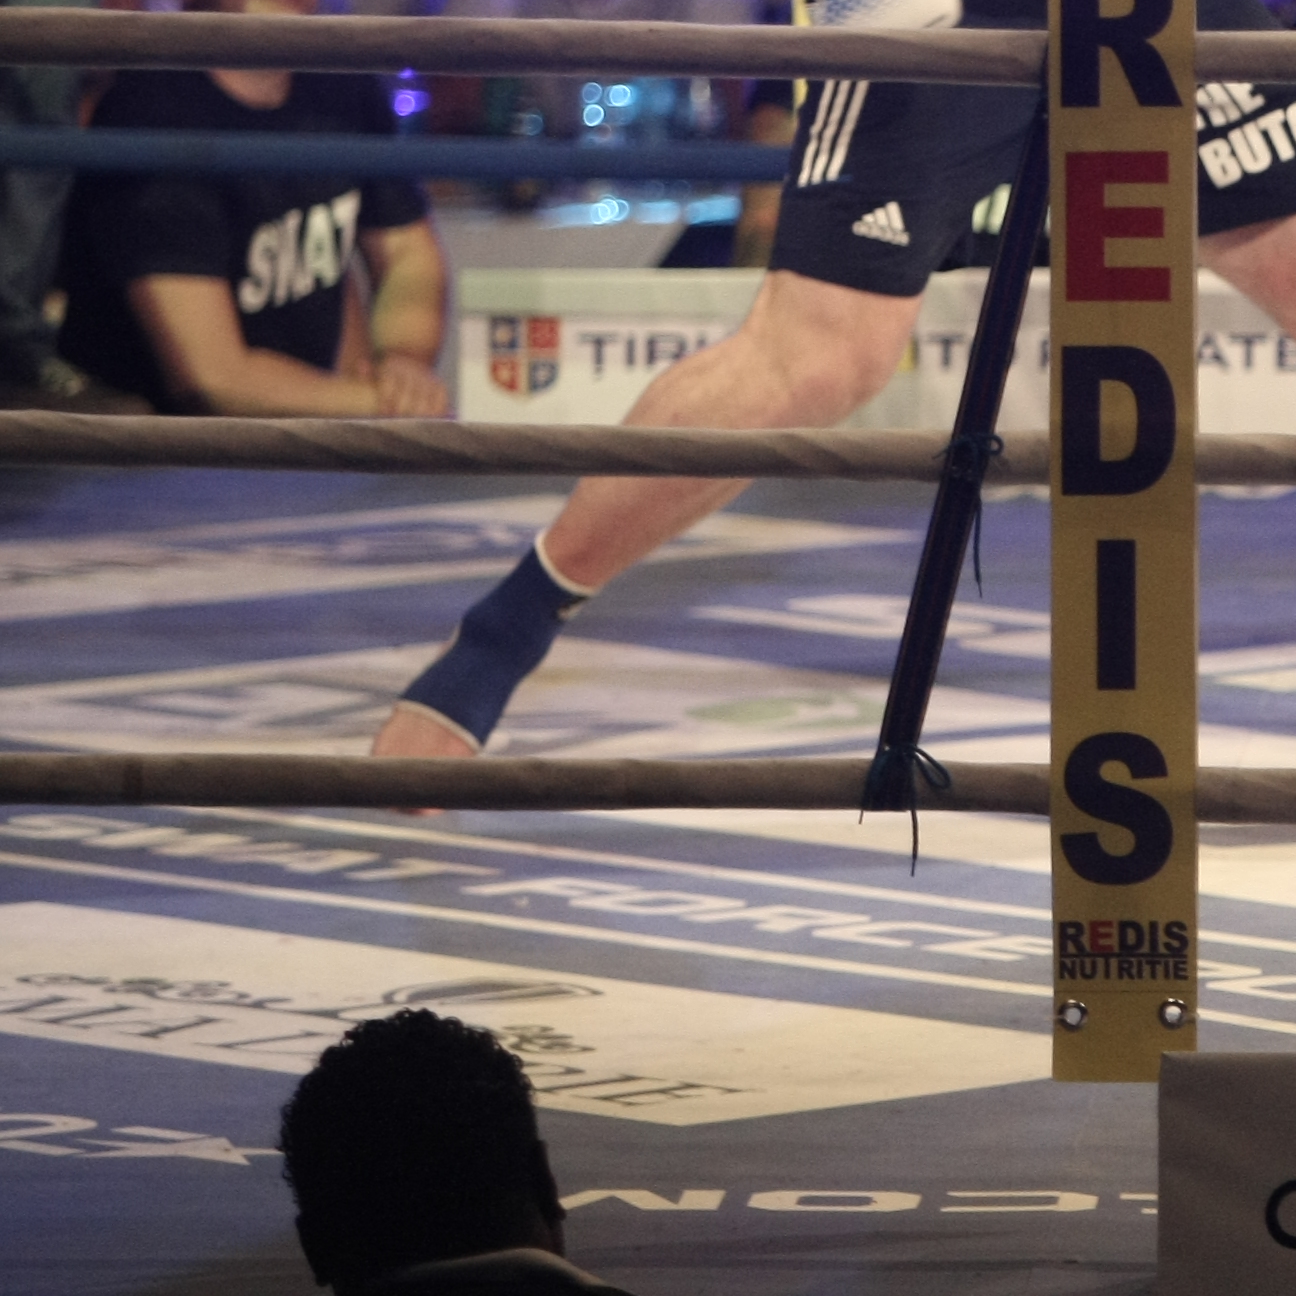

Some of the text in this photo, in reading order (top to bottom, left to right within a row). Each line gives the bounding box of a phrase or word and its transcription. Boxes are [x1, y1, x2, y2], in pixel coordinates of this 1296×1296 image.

[238, 189, 363, 315] SWAT
[4, 812, 505, 882] SWAT
[464, 876, 1052, 962] FORCE
[1058, 920, 1189, 954] REDIS
[1058, 957, 1189, 981] NUTRITIE
